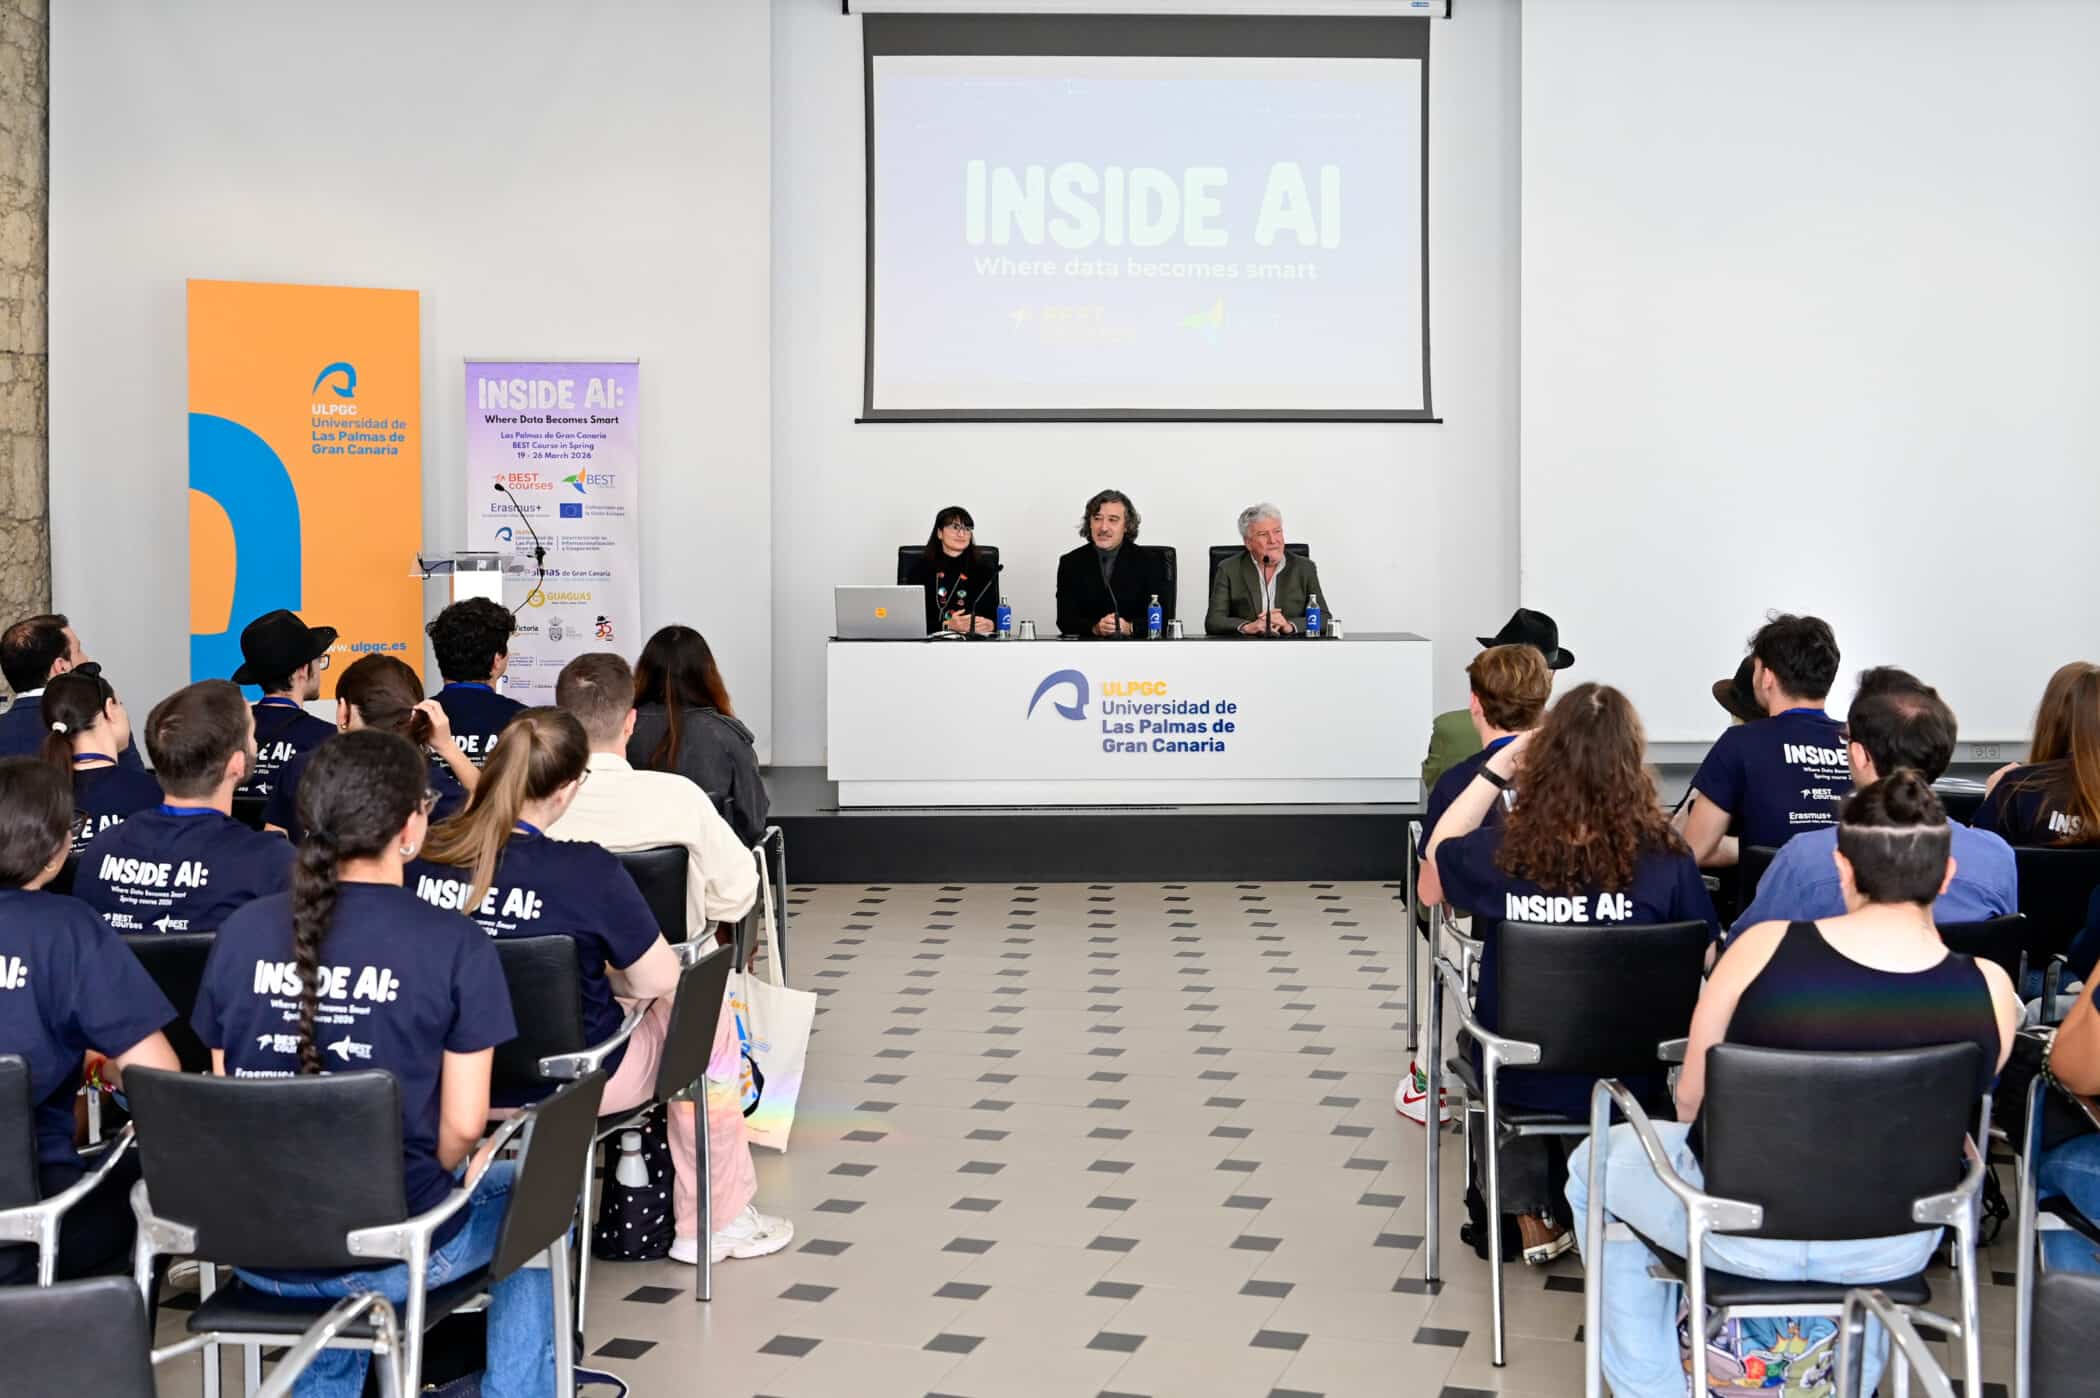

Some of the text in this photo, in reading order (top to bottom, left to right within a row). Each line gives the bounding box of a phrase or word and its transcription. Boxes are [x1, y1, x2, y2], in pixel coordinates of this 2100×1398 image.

[966, 159, 1341, 249] INSIDE AI
[974, 255, 1319, 281] Where data becomes smart
[478, 377, 625, 410] INSIDE AI:
[311, 403, 357, 415] ULPGC
[312, 418, 407, 429] Universidad de
[485, 415, 619, 424] Where Data Becomes Smart
[312, 431, 406, 442] Las Palmas de
[500, 431, 514, 439] Las
[515, 431, 543, 439] Palmas
[555, 431, 575, 439] Gran
[312, 443, 399, 455] Gran Canaria
[569, 442, 594, 451] Spring
[508, 473, 539, 482] BEST
[586, 474, 616, 484] BEST
[508, 482, 553, 490] courses
[546, 592, 592, 601] GUAGUAS
[1102, 681, 1168, 697] ULPGC
[1102, 699, 1238, 716] Universidad de
[1102, 719, 1236, 734] Las Palmas de
[1102, 737, 1226, 753] Gran Canaria
[99, 853, 209, 888] INSIDE AI:
[501, 887, 543, 920] AI:
[1505, 892, 1633, 923] INSIDE AI:
[253, 959, 400, 1003] INSDE AI:
